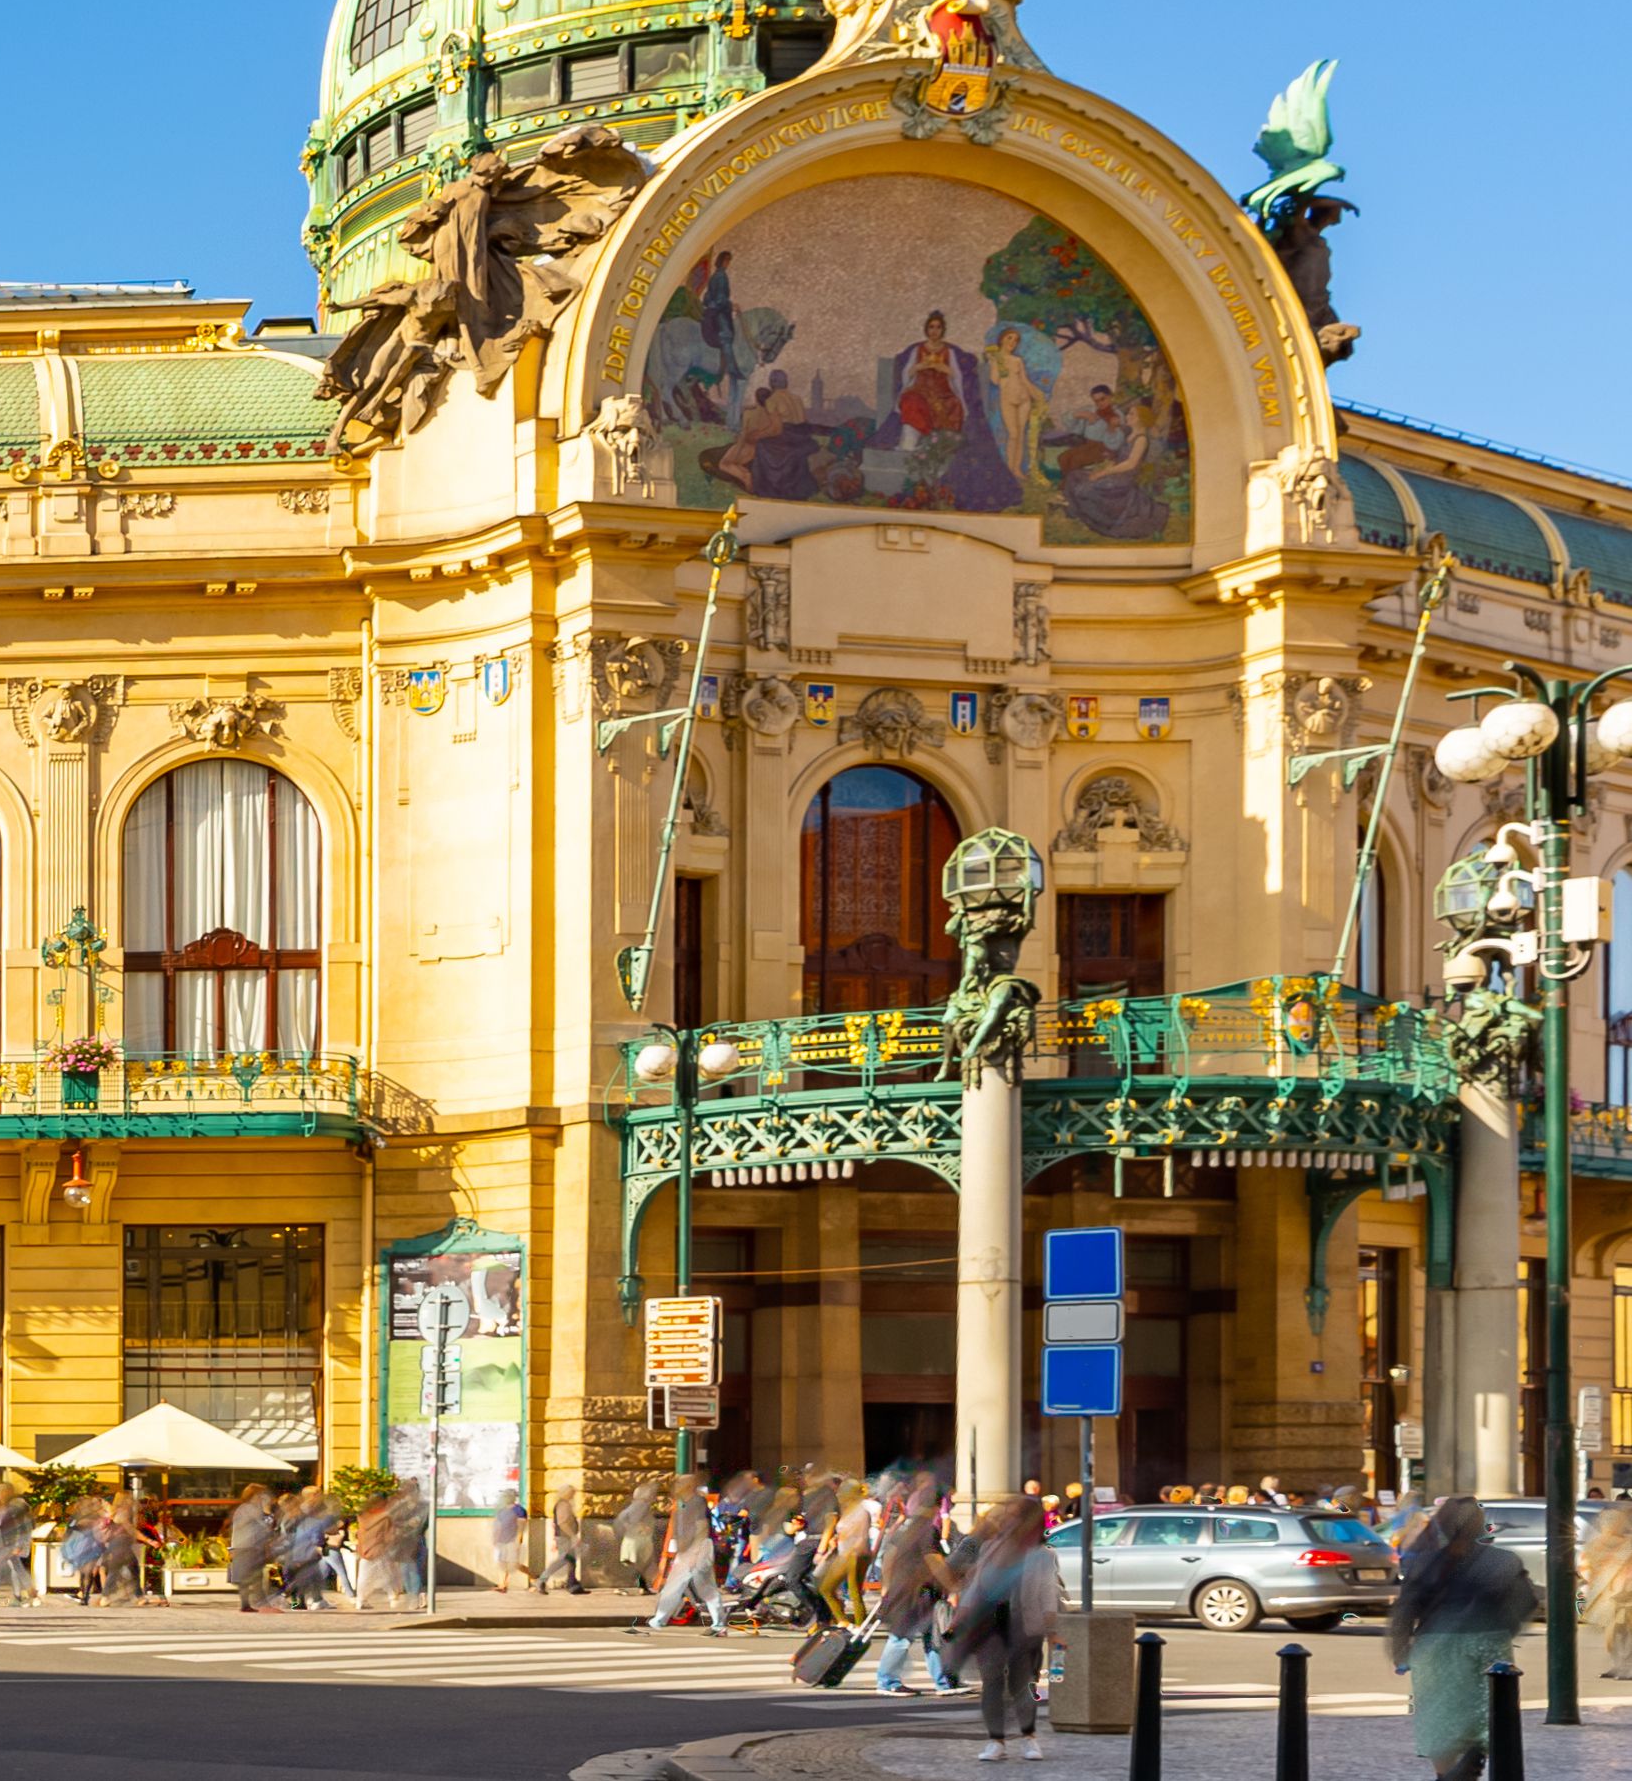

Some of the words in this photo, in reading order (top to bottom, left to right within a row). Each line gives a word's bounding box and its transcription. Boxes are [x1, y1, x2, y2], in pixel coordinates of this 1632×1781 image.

[601, 324, 632, 385] ZDAR
[694, 134, 782, 200] VZDORUJ
[1009, 112, 1054, 143] JAK
